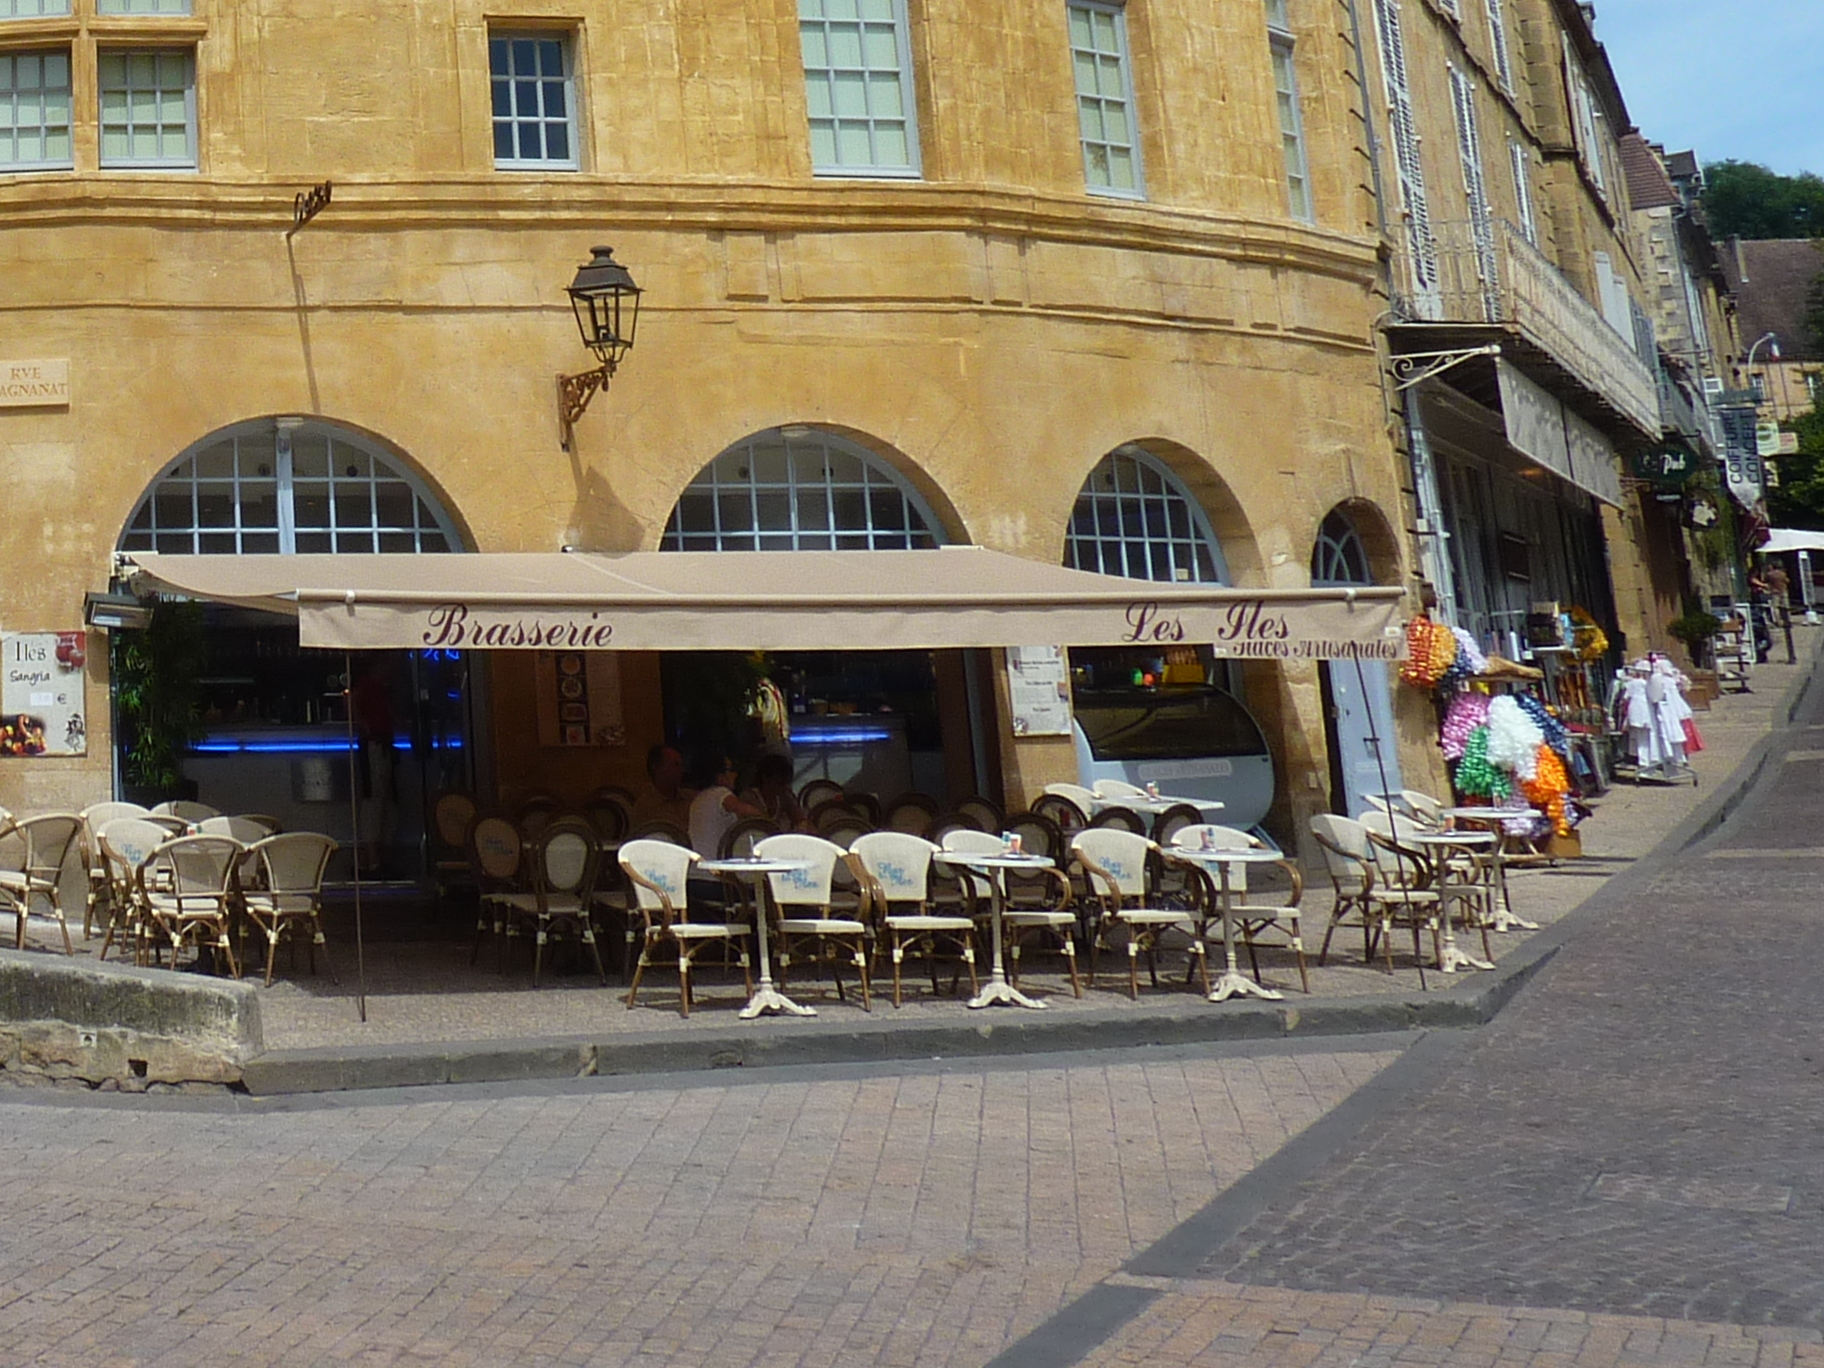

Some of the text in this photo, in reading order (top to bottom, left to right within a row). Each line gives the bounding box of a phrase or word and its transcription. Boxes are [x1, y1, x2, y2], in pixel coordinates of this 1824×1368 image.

[10, 367, 41, 380] RVE
[1722, 412, 1743, 484] COIFFURE
[1659, 454, 1686, 475] Pub
[422, 602, 614, 647] Brasserie
[1121, 599, 1289, 643] Les Iles
[9, 670, 51, 686] Sangria
